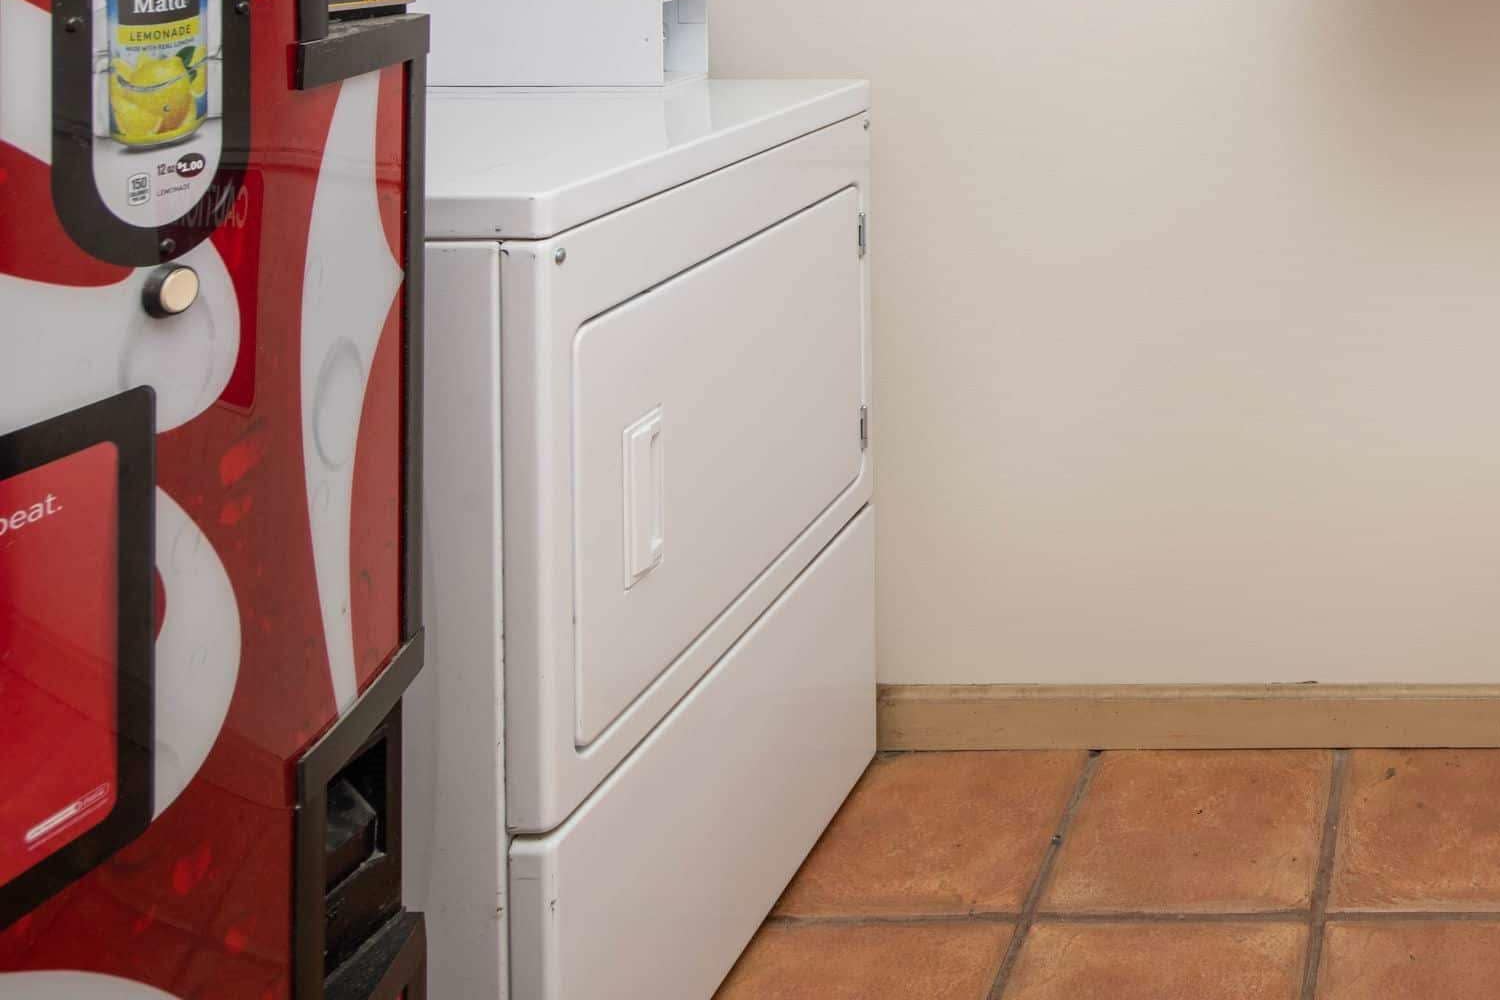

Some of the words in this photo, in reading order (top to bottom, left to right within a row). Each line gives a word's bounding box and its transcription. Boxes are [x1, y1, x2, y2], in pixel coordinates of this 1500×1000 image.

[129, 23, 192, 42] LEMONADE
[157, 163, 166, 176] 12
[177, 159, 204, 173] $1.00
[131, 175, 148, 191] 150
